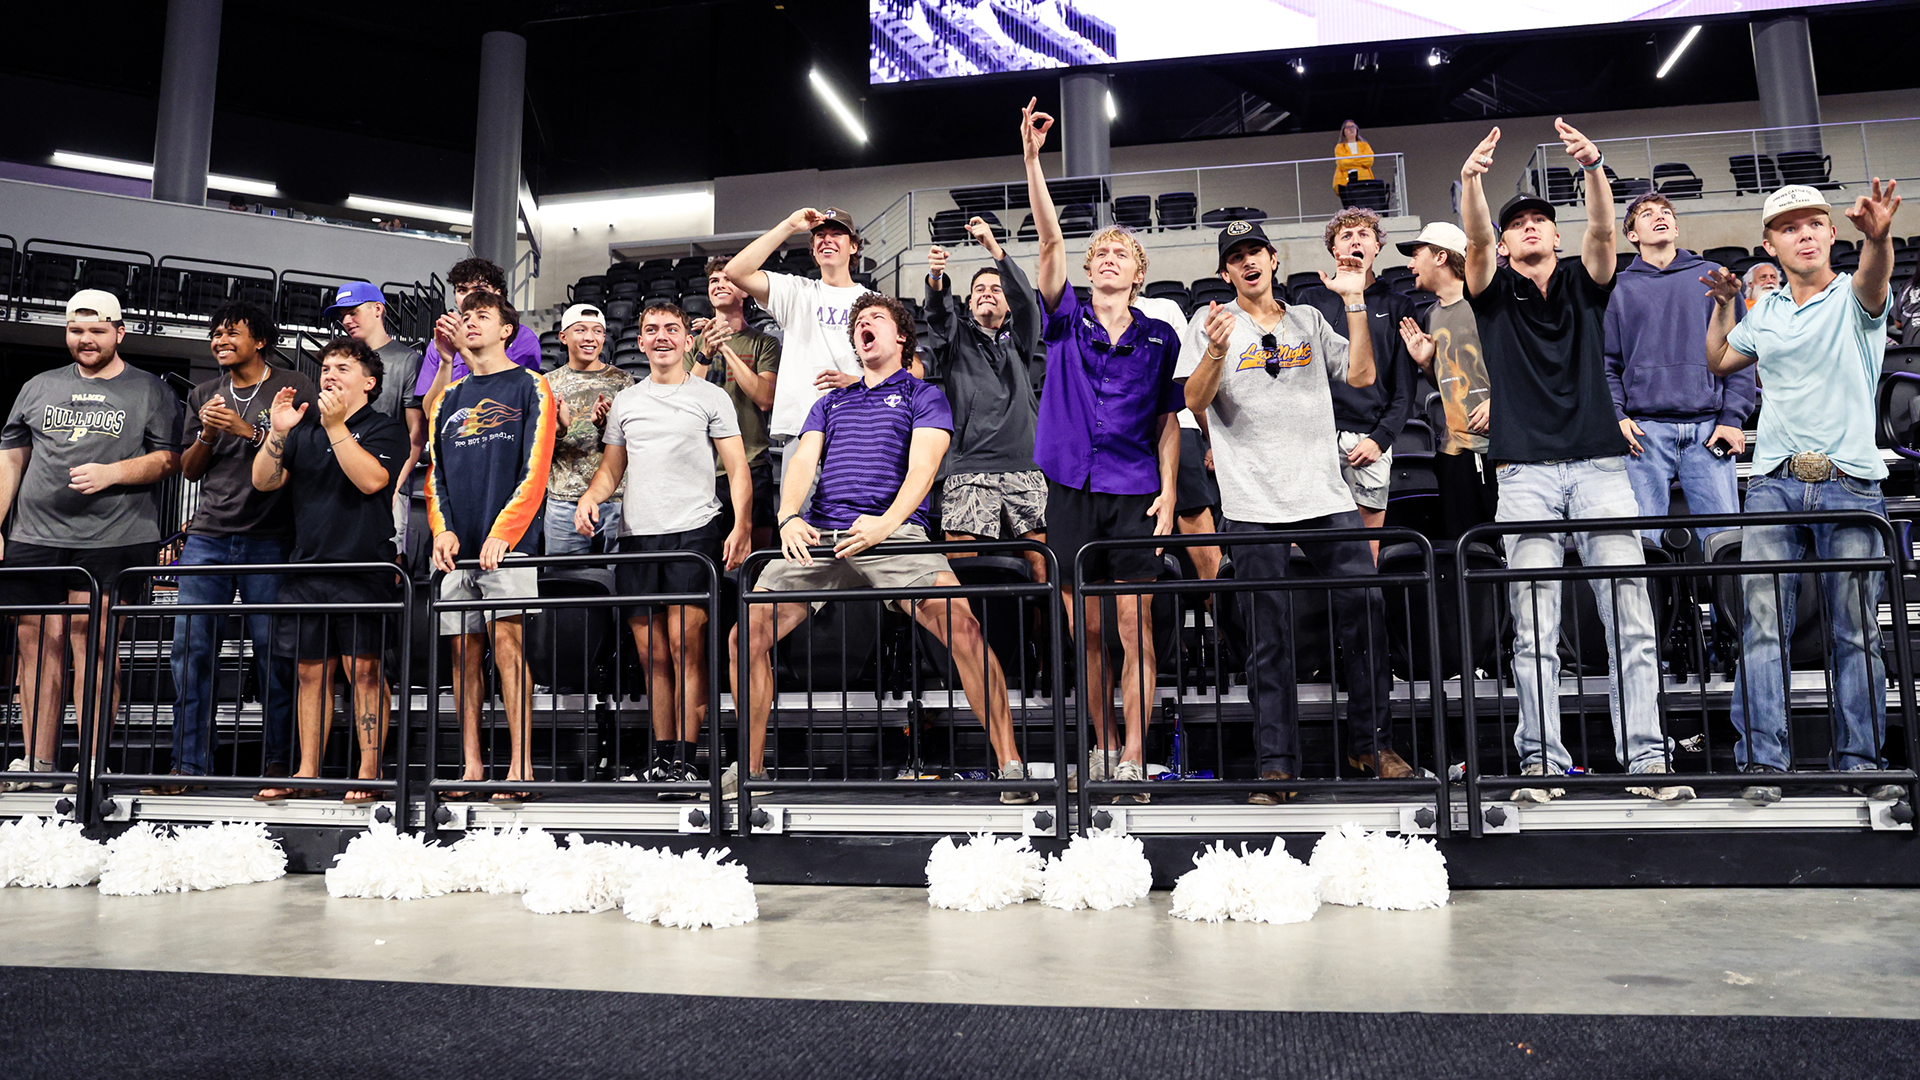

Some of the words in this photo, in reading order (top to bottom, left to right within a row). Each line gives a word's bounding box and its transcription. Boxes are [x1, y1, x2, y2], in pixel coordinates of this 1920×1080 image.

[1278, 341, 1313, 363] Night
[71, 393, 106, 402] PALMER
[42, 404, 126, 435] BULLDOGS
[67, 427, 88, 442] P
